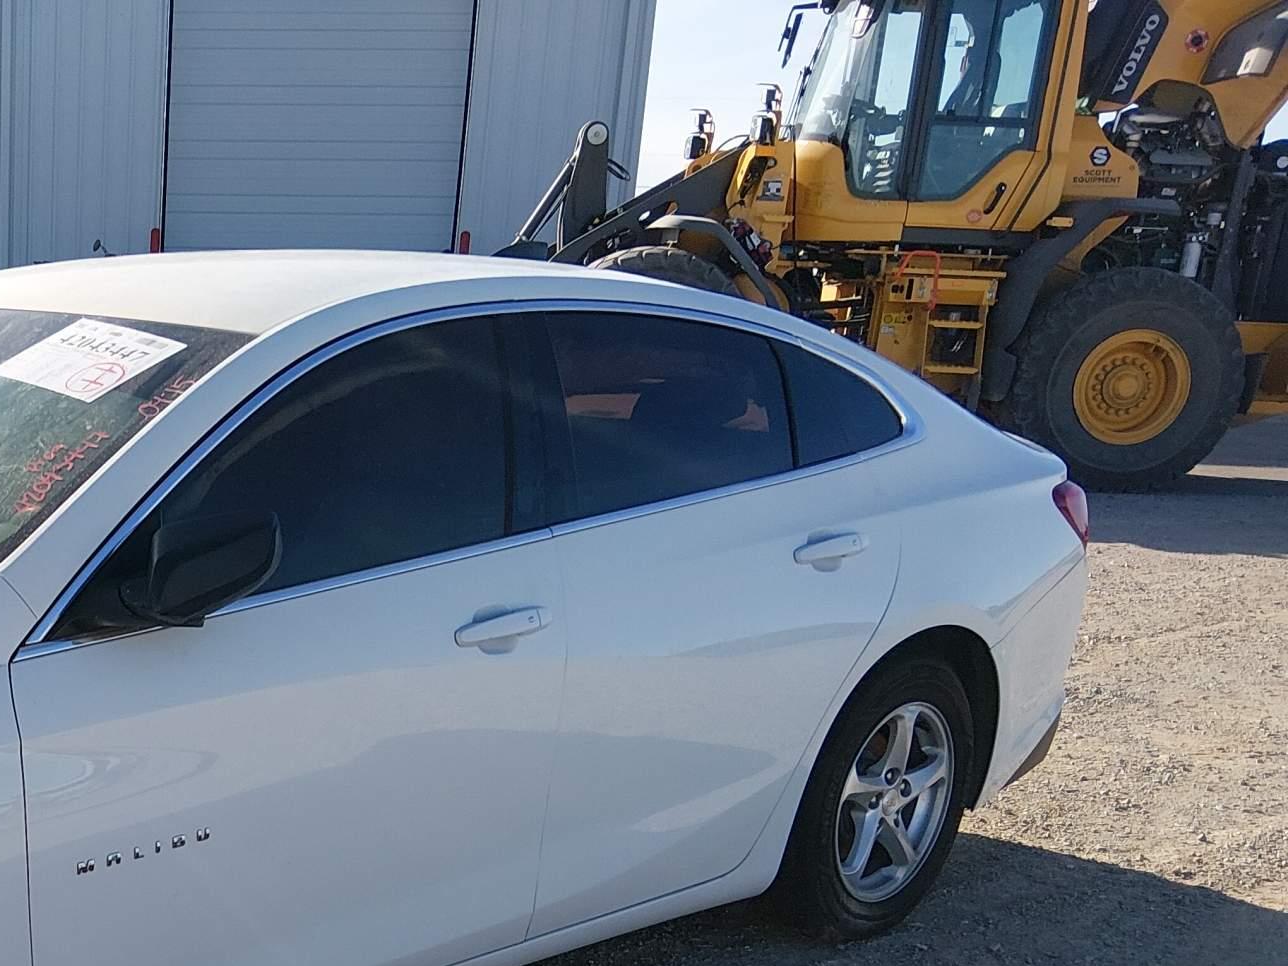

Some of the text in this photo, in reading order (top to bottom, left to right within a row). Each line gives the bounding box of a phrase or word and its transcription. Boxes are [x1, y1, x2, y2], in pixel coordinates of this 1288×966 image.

[1111, 14, 1160, 95] VOLVO
[1072, 176, 1121, 184] EQUIPMENT
[1083, 169, 1113, 177] SCOTT
[76, 827, 210, 876] MALIBU
